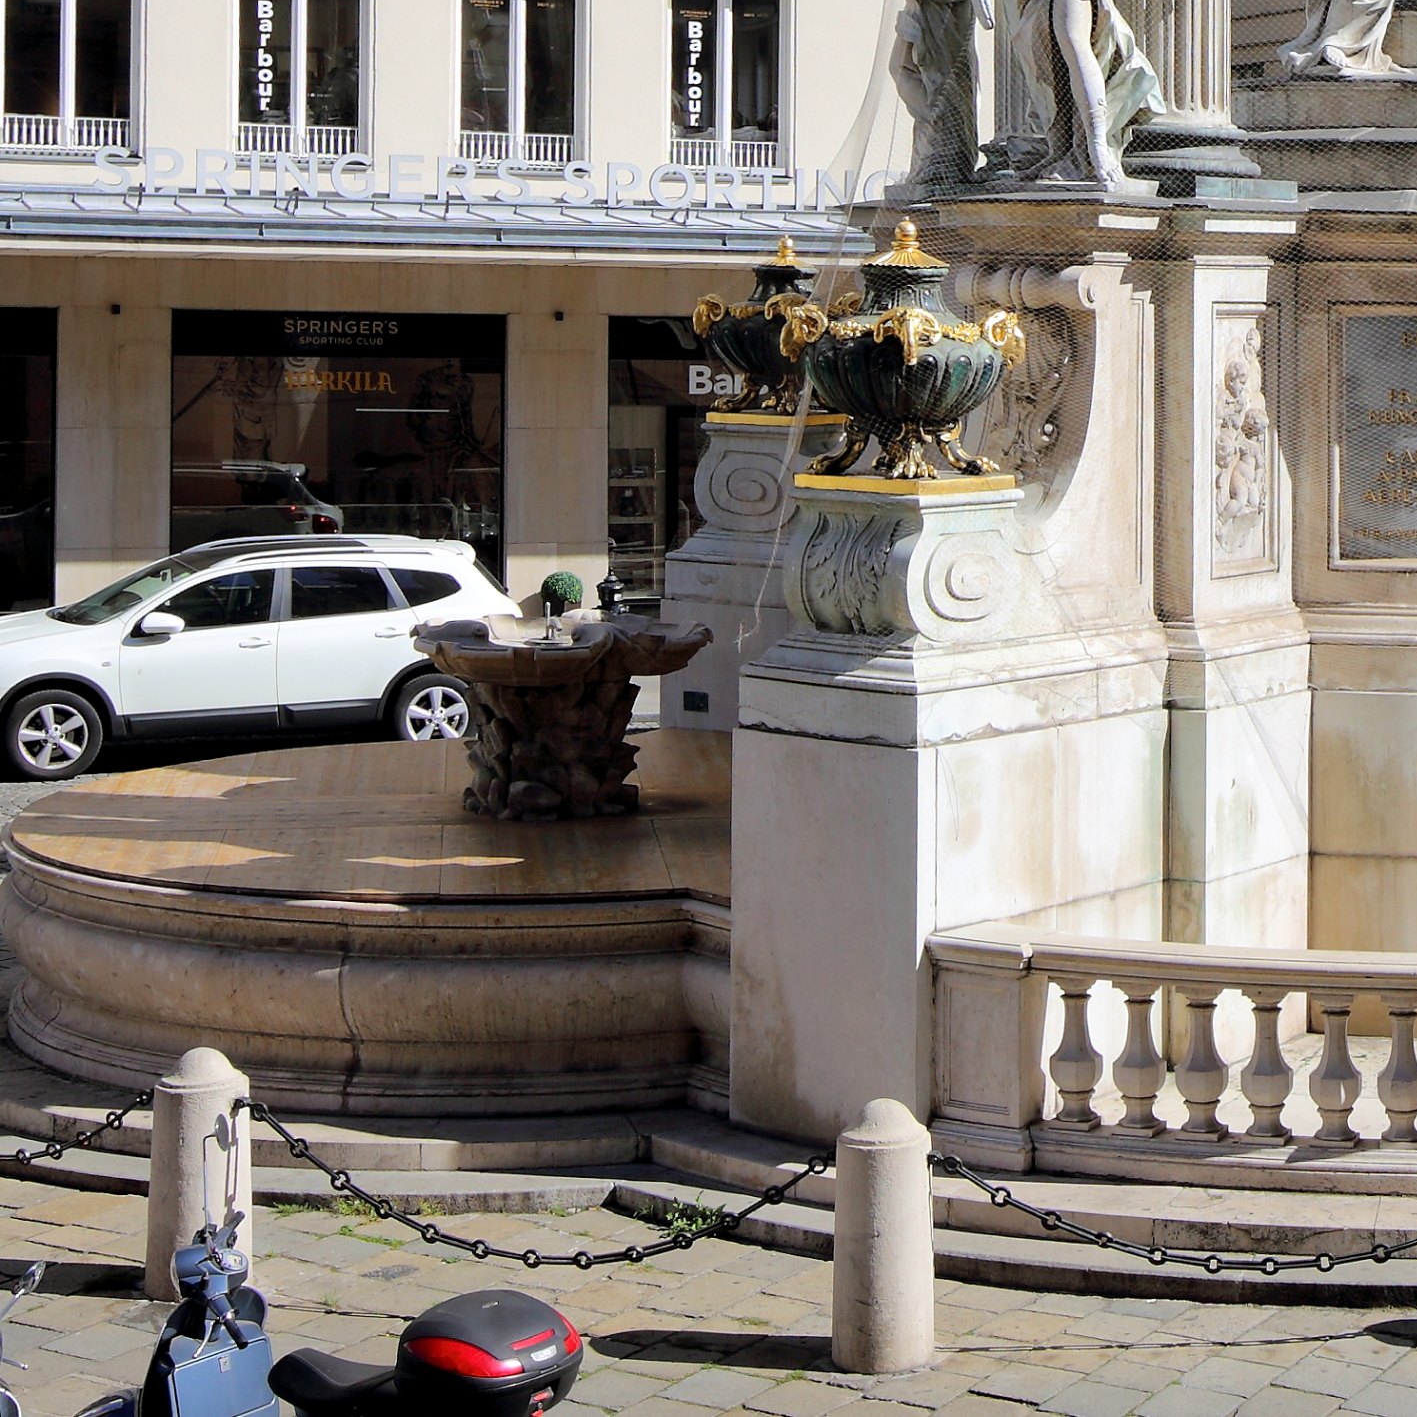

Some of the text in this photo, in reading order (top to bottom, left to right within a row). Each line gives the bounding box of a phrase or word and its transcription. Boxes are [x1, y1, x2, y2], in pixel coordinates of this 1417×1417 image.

[94, 145, 530, 204] SPRINGER'S
[284, 318, 399, 335] SPRINGER'S
[300, 336, 384, 346] SPORTING CLUB
